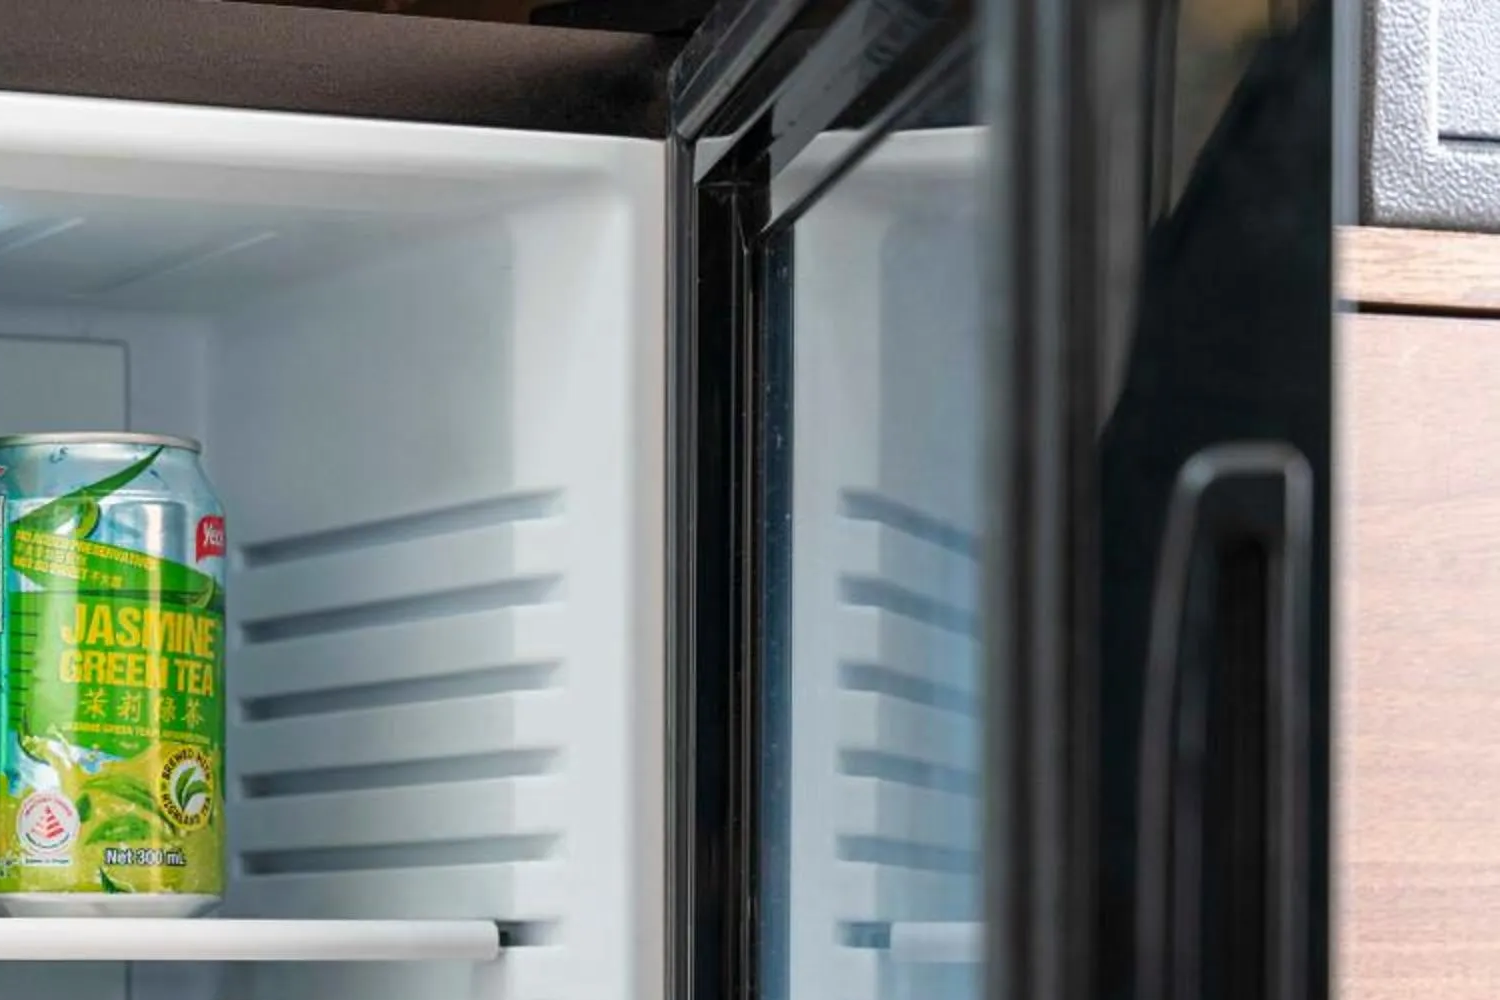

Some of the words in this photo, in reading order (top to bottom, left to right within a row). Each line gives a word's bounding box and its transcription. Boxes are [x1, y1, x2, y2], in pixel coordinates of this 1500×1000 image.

[61, 602, 216, 658] JASMINE
[59, 650, 168, 688] GREEN
[175, 660, 214, 696] TEA
[104, 848, 133, 866] Net
[136, 848, 164, 866] 300
